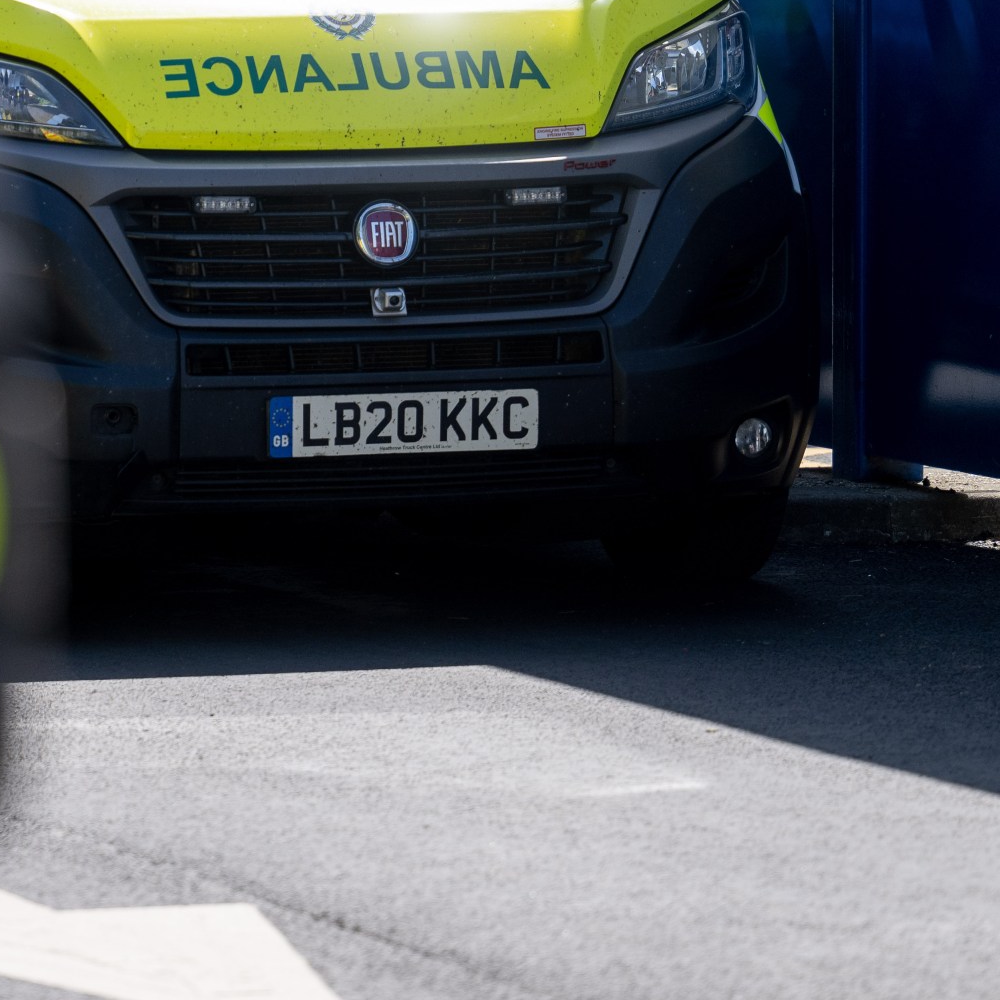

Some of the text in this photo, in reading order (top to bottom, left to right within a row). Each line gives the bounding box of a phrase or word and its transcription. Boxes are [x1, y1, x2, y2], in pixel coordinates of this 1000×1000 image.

[563, 157, 616, 171] Power
[371, 221, 404, 248] FIAT
[302, 395, 530, 447] LB20 KKC
[273, 435, 289, 448] GB
